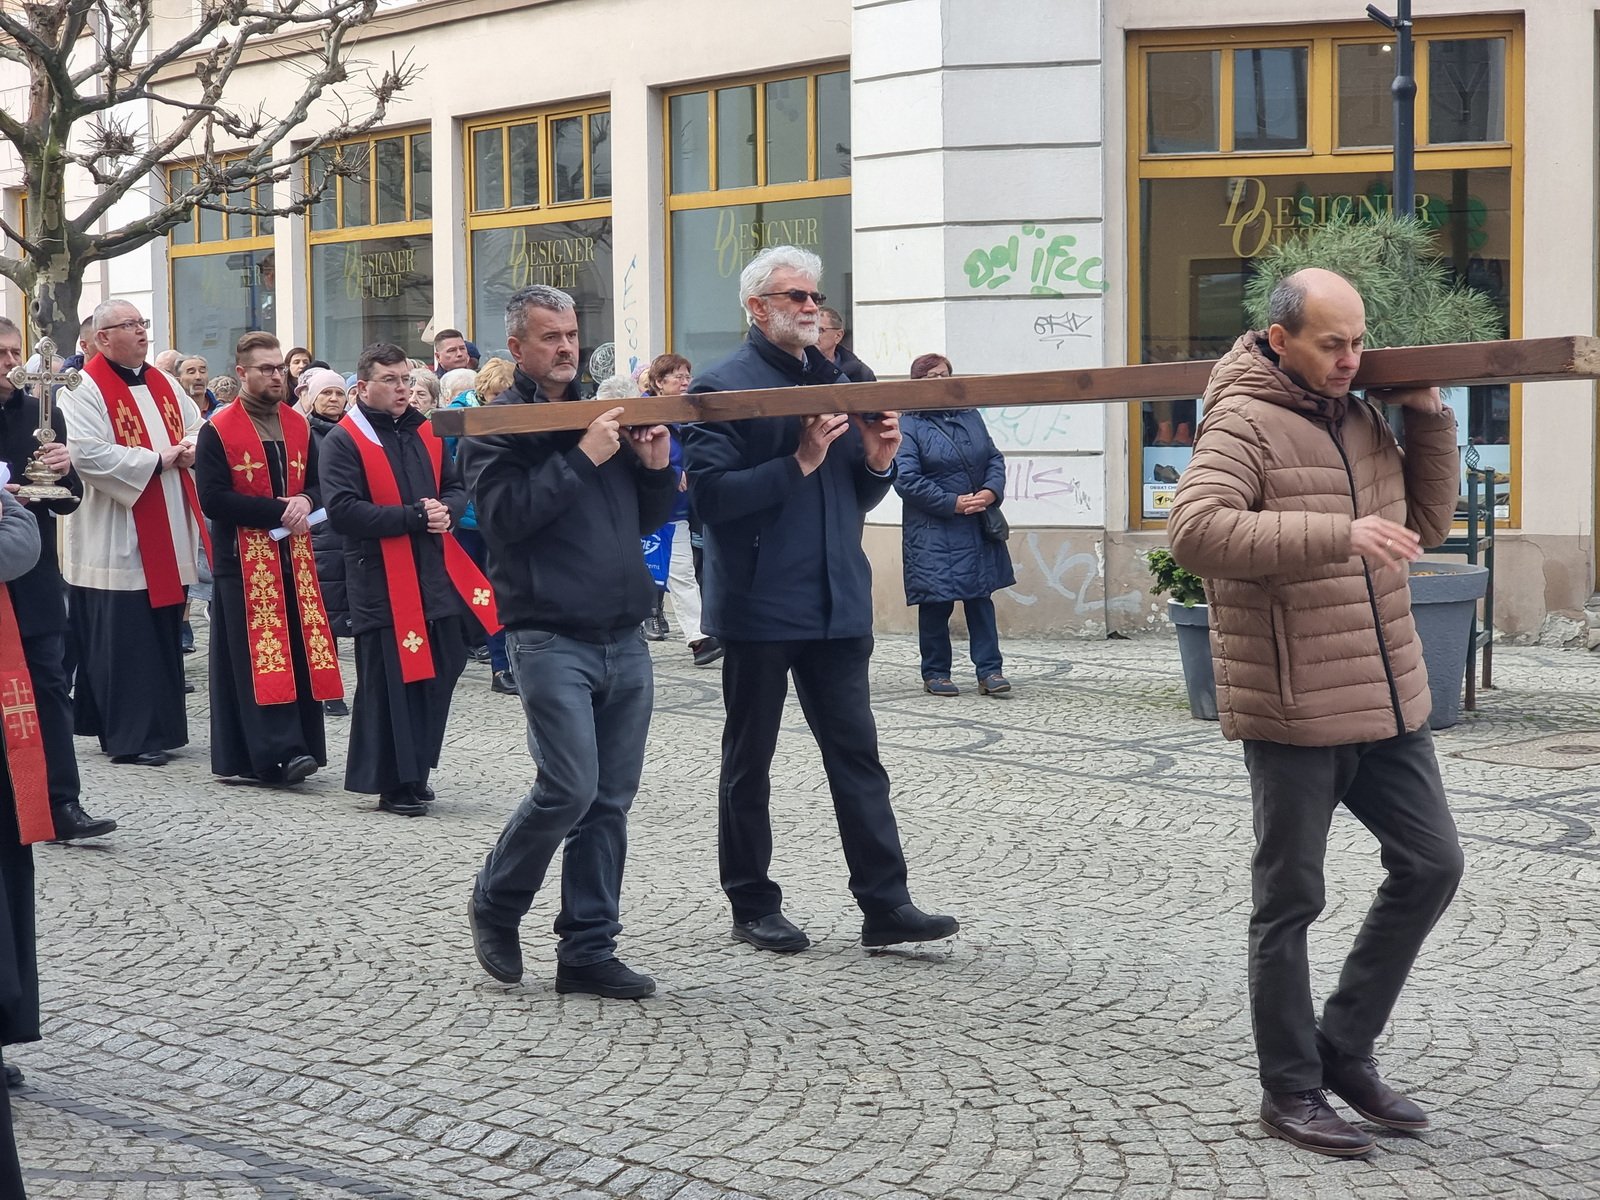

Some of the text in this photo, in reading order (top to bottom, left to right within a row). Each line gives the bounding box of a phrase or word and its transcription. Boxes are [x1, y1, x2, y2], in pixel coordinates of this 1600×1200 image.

[1219, 177, 1432, 227] DESIGNR
[510, 228, 595, 266] DESIGNER
[713, 208, 819, 251] DESIGNER
[343, 244, 415, 278] DESIGNER
[512, 251, 579, 290] OUTLET
[346, 264, 402, 300] OUTLET
